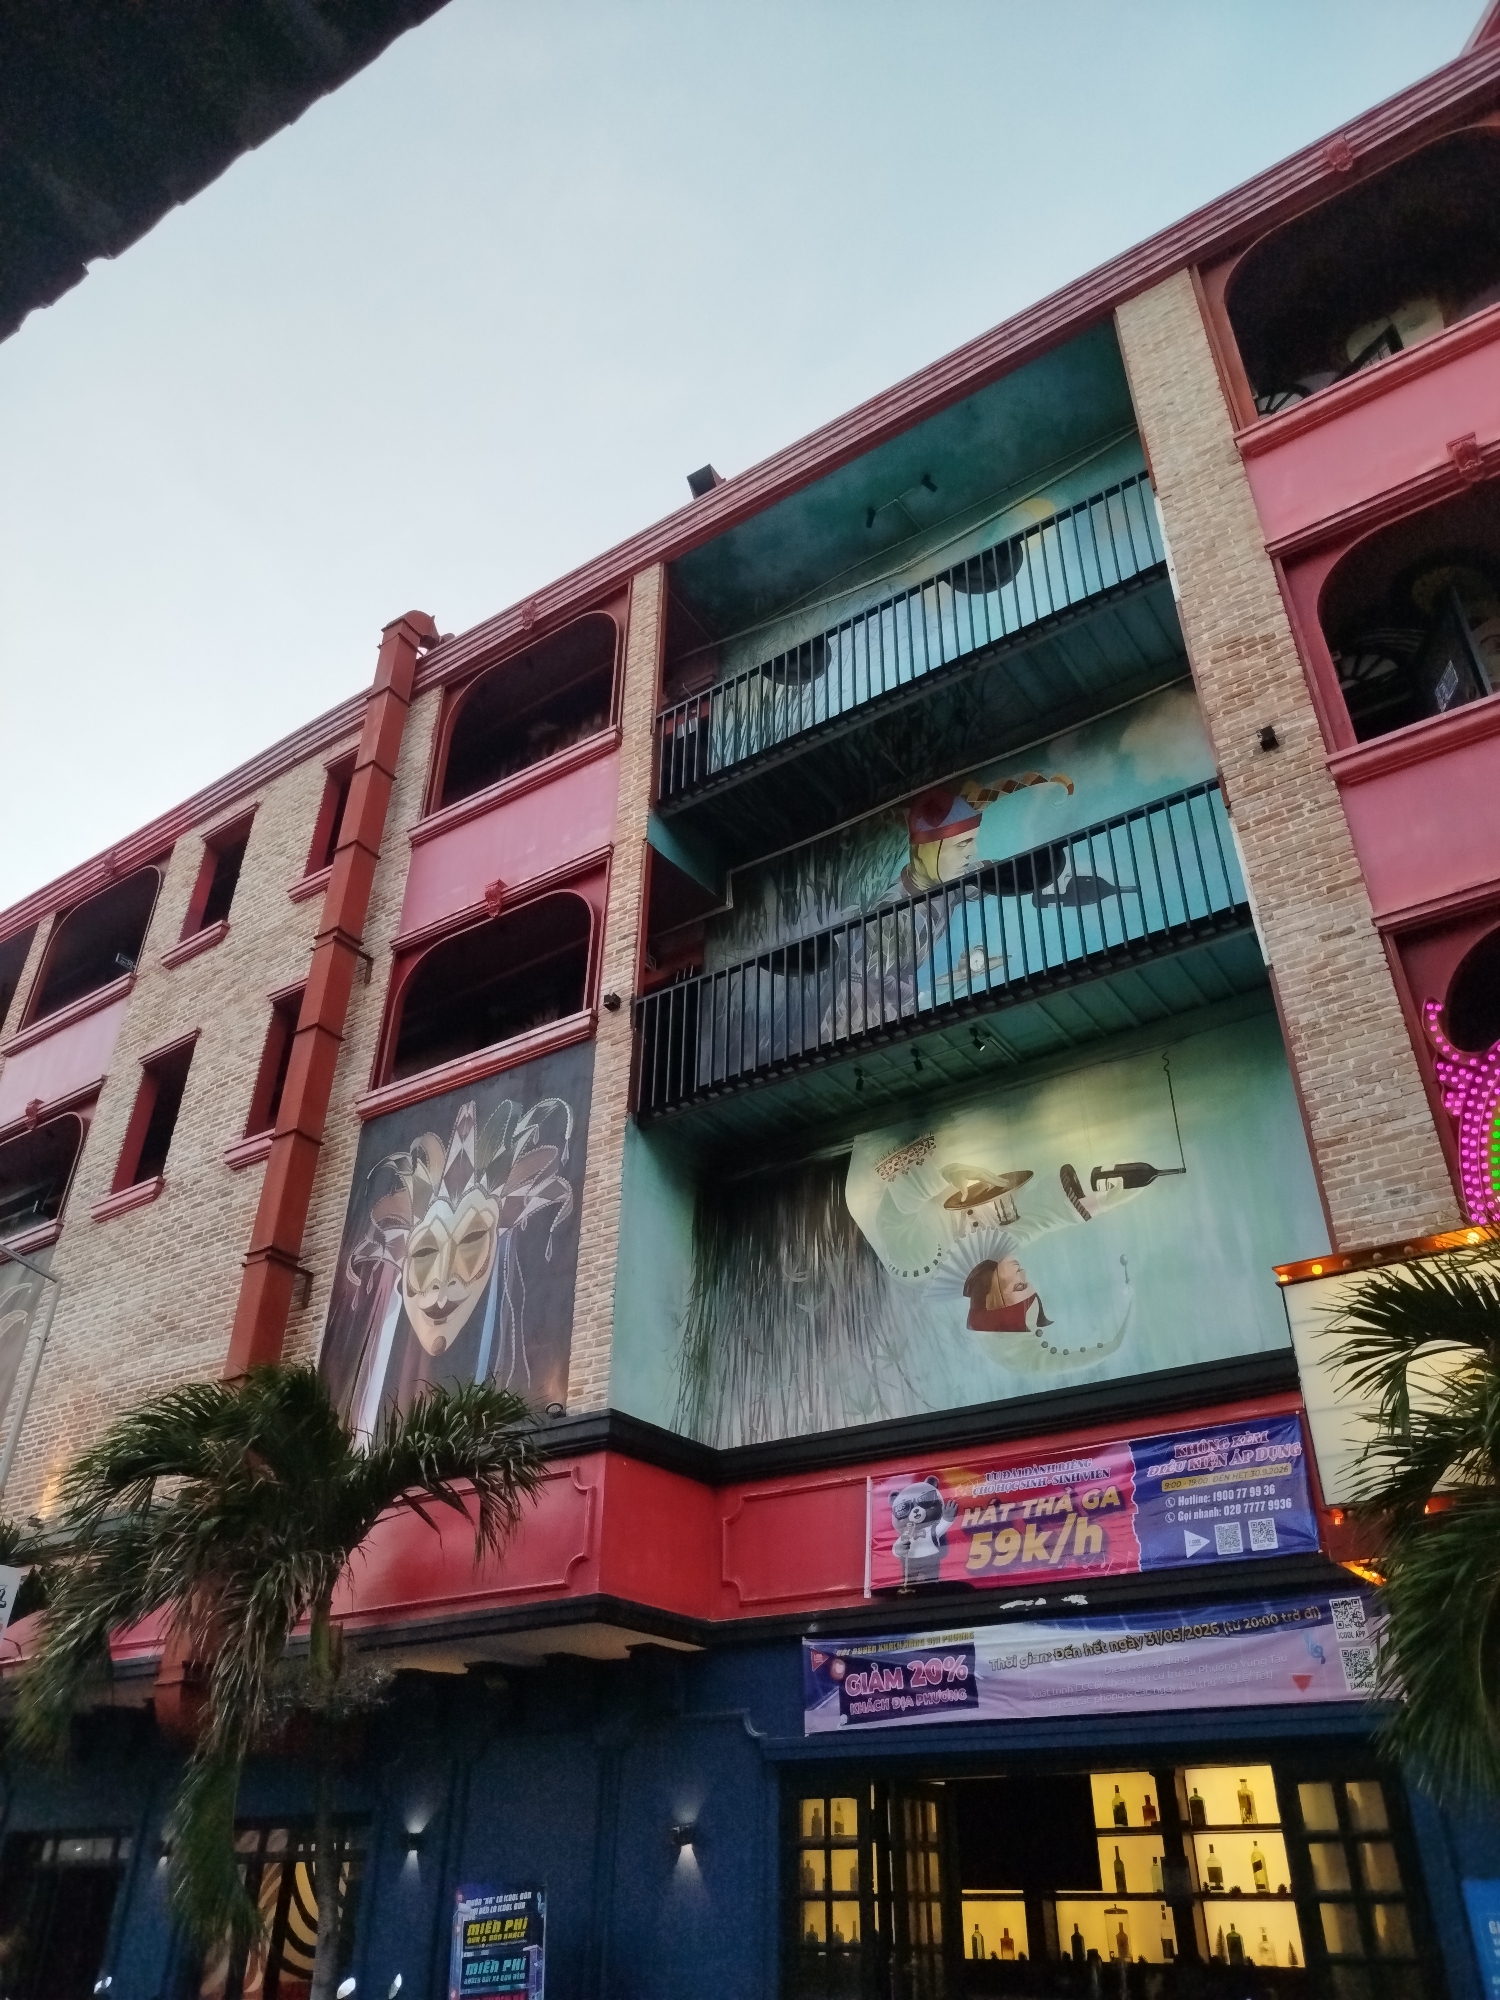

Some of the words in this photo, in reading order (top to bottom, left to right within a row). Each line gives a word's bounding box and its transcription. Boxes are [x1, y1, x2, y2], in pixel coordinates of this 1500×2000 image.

[1174, 1436, 1230, 1459] KHÔNG
[1231, 1430, 1269, 1447] KÈM
[1021, 1462, 1057, 1479] DÀNH
[1147, 1457, 1187, 1478] ĐIỀU
[1188, 1450, 1229, 1471] KIỆN
[1229, 1446, 1255, 1465] ÁP
[1255, 1442, 1302, 1462] DỤNG
[995, 1480, 1019, 1495] HỌC
[1018, 1475, 1047, 1490] SINH
[1052, 1471, 1081, 1486] SINH
[1081, 1467, 1112, 1482] VIÊN
[1164, 1480, 1181, 1490] 9:00
[1250, 1466, 1289, 1477] 30.9.2026
[961, 1498, 1016, 1527] HÁT
[1022, 1486, 1074, 1519] THẢ
[1081, 1485, 1121, 1510] GA
[1178, 1493, 1211, 1506] Hotline:
[1213, 1490, 1235, 1502] 1900
[1236, 1488, 1248, 1499] 77
[1249, 1486, 1262, 1497] 99
[1263, 1484, 1276, 1495] 36
[1178, 1510, 1192, 1523] Gọi
[1193, 1506, 1221, 1519] nhanh:
[1223, 1503, 1241, 1516] 028
[1244, 1500, 1266, 1513] 7777
[1268, 1498, 1292, 1510] 9936
[965, 1513, 1103, 1569] 59k/h
[989, 1655, 1018, 1671] Thời
[1020, 1651, 1052, 1670] gian:
[1053, 1643, 1082, 1661] Đến
[1083, 1639, 1108, 1657] hết
[1109, 1635, 1144, 1656] ngày
[1144, 1621, 1220, 1647] 31/05/2026
[1242, 1613, 1279, 1629] 20:00
[1281, 1608, 1301, 1623] trở
[1304, 1606, 1322, 1620] đi)
[845, 1663, 904, 1696] GIẢM
[907, 1655, 969, 1688] 20%
[850, 1697, 890, 1715] KHÁCH
[891, 1695, 914, 1712] ĐỊA
[916, 1688, 967, 1707] PHƯƠNG
[467, 1920, 502, 1936] MIỄN
[504, 1915, 529, 1933] PHÍ
[465, 1959, 500, 1976] MIỄN
[502, 1956, 527, 1972] PHÍ
